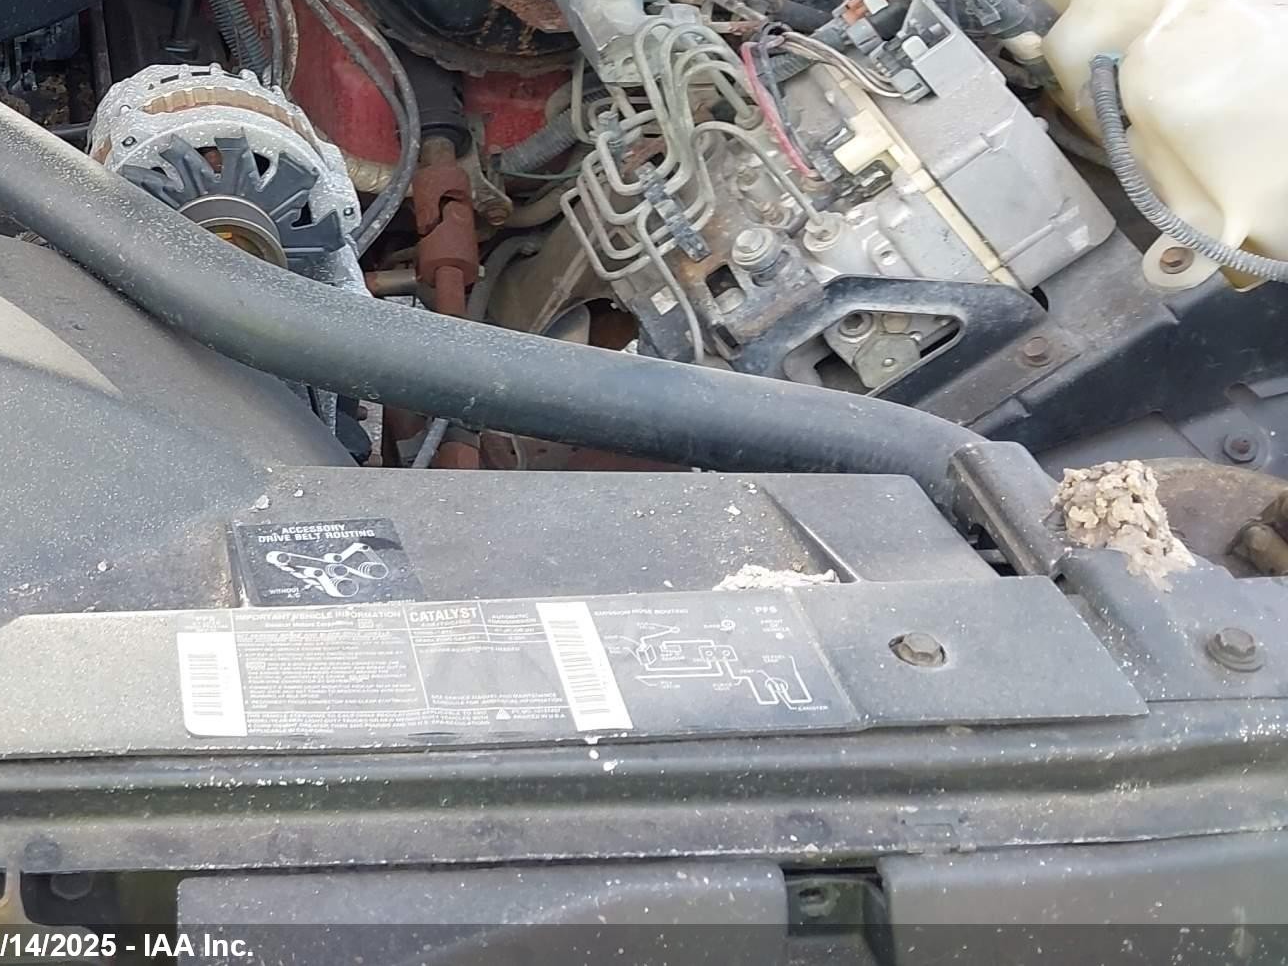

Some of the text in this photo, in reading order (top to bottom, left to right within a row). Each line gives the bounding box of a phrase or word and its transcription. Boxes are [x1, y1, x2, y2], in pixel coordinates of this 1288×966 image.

[281, 524, 346, 535] ACCESSORY
[258, 529, 376, 543] DRIVE BELT ROUTING
[234, 610, 401, 621] IMPORTANT VEHICLE INFORMATION
[410, 607, 478, 622] CATALYST
